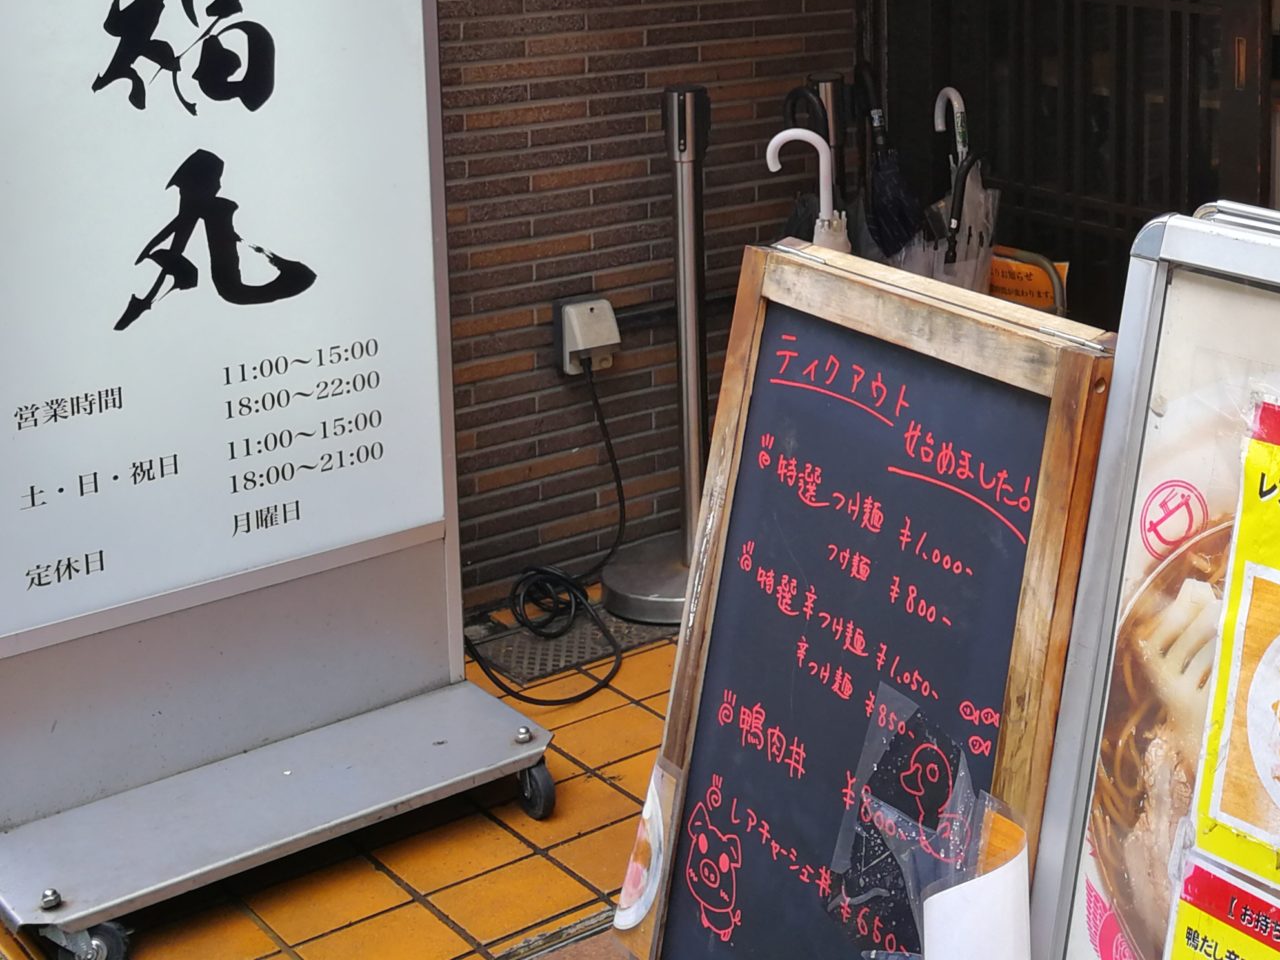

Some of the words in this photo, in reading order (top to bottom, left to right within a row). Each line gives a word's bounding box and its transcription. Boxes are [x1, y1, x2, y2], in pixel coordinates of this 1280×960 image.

[222, 338, 380, 386] 11:00～15:00
[13, 386, 124, 431] 営業時間
[224, 370, 381, 420] 18:00～22:00
[227, 409, 383, 461] 11:00～15:00
[20, 453, 180, 511] 土・日・祝日
[229, 441, 385, 494] 18:00～21:00
[231, 499, 301, 538] 月曜日
[776, 455, 885, 533] 特選つけ麺
[25, 550, 106, 591] 定休日
[827, 544, 871, 581] つけ麺
[739, 702, 807, 780] 鴨肉丼
